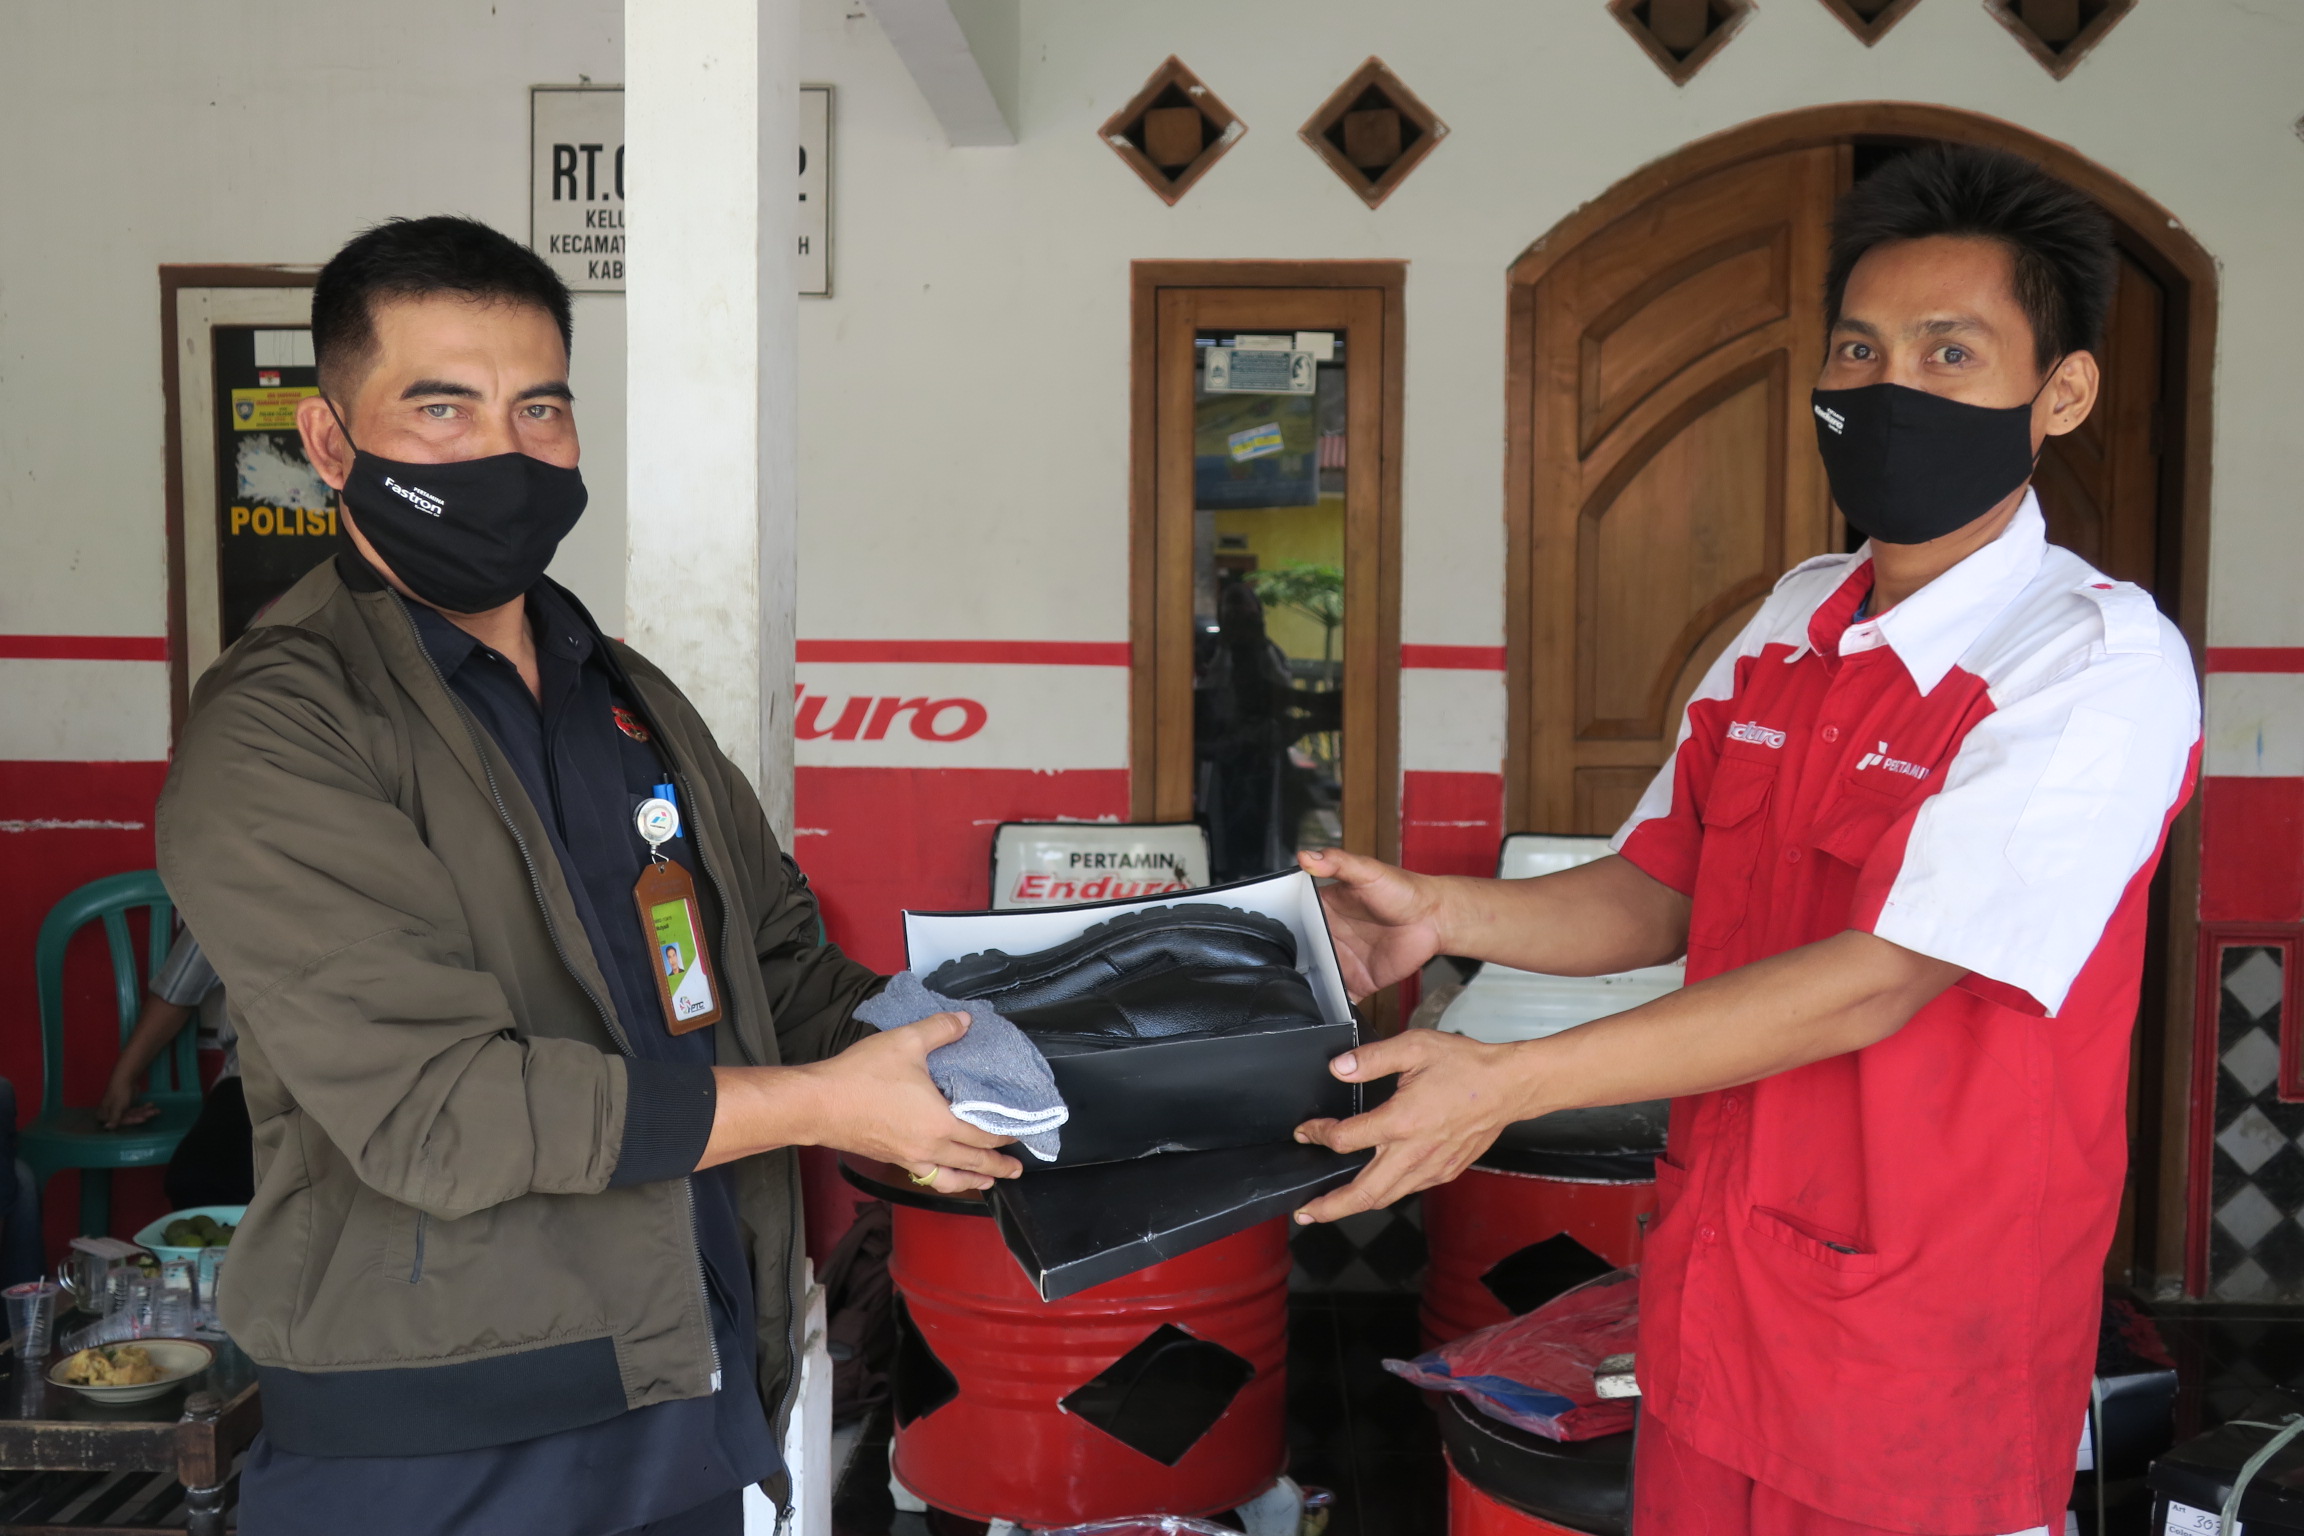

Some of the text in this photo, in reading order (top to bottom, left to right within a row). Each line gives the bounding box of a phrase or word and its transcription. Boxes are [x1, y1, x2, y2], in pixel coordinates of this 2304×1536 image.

[588, 260, 625, 279] KAB
[384, 476, 442, 515] Fastron
[231, 506, 337, 536] POLISI
[1726, 721, 1787, 749] duro
[2172, 1504, 2187, 1513] Art
